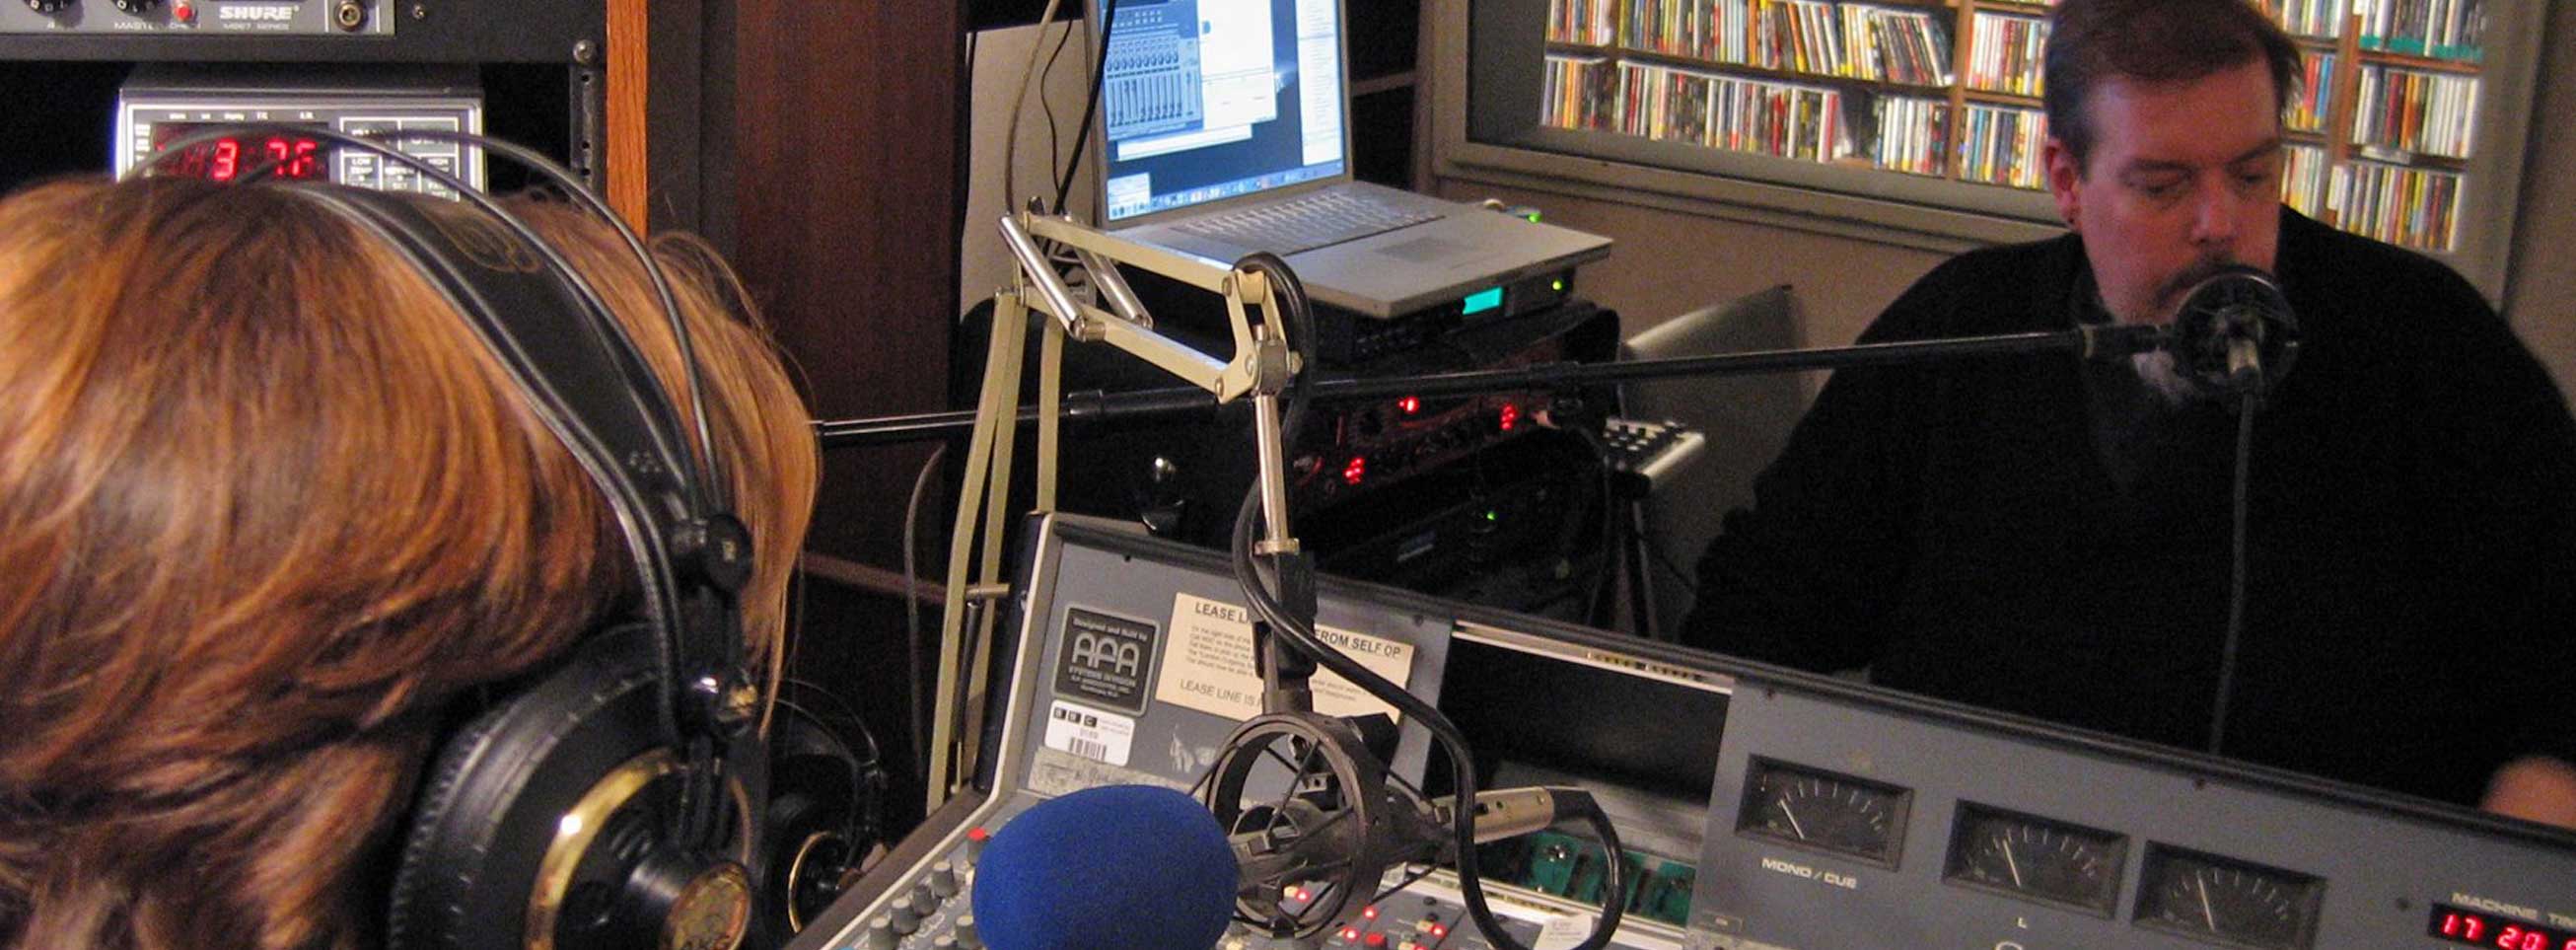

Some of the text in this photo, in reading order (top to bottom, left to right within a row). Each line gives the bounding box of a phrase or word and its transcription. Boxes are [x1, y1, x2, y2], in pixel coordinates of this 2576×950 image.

[219, 6, 293, 21] SHURE
[1195, 603, 1236, 621] LEASE
[1351, 637, 1382, 654] SELF
[1180, 679, 1255, 707] LEASE LINE IS
[1761, 858, 1812, 879] MONO
[1824, 872, 1857, 890] CUE
[2452, 892, 2538, 920] MACHINE
